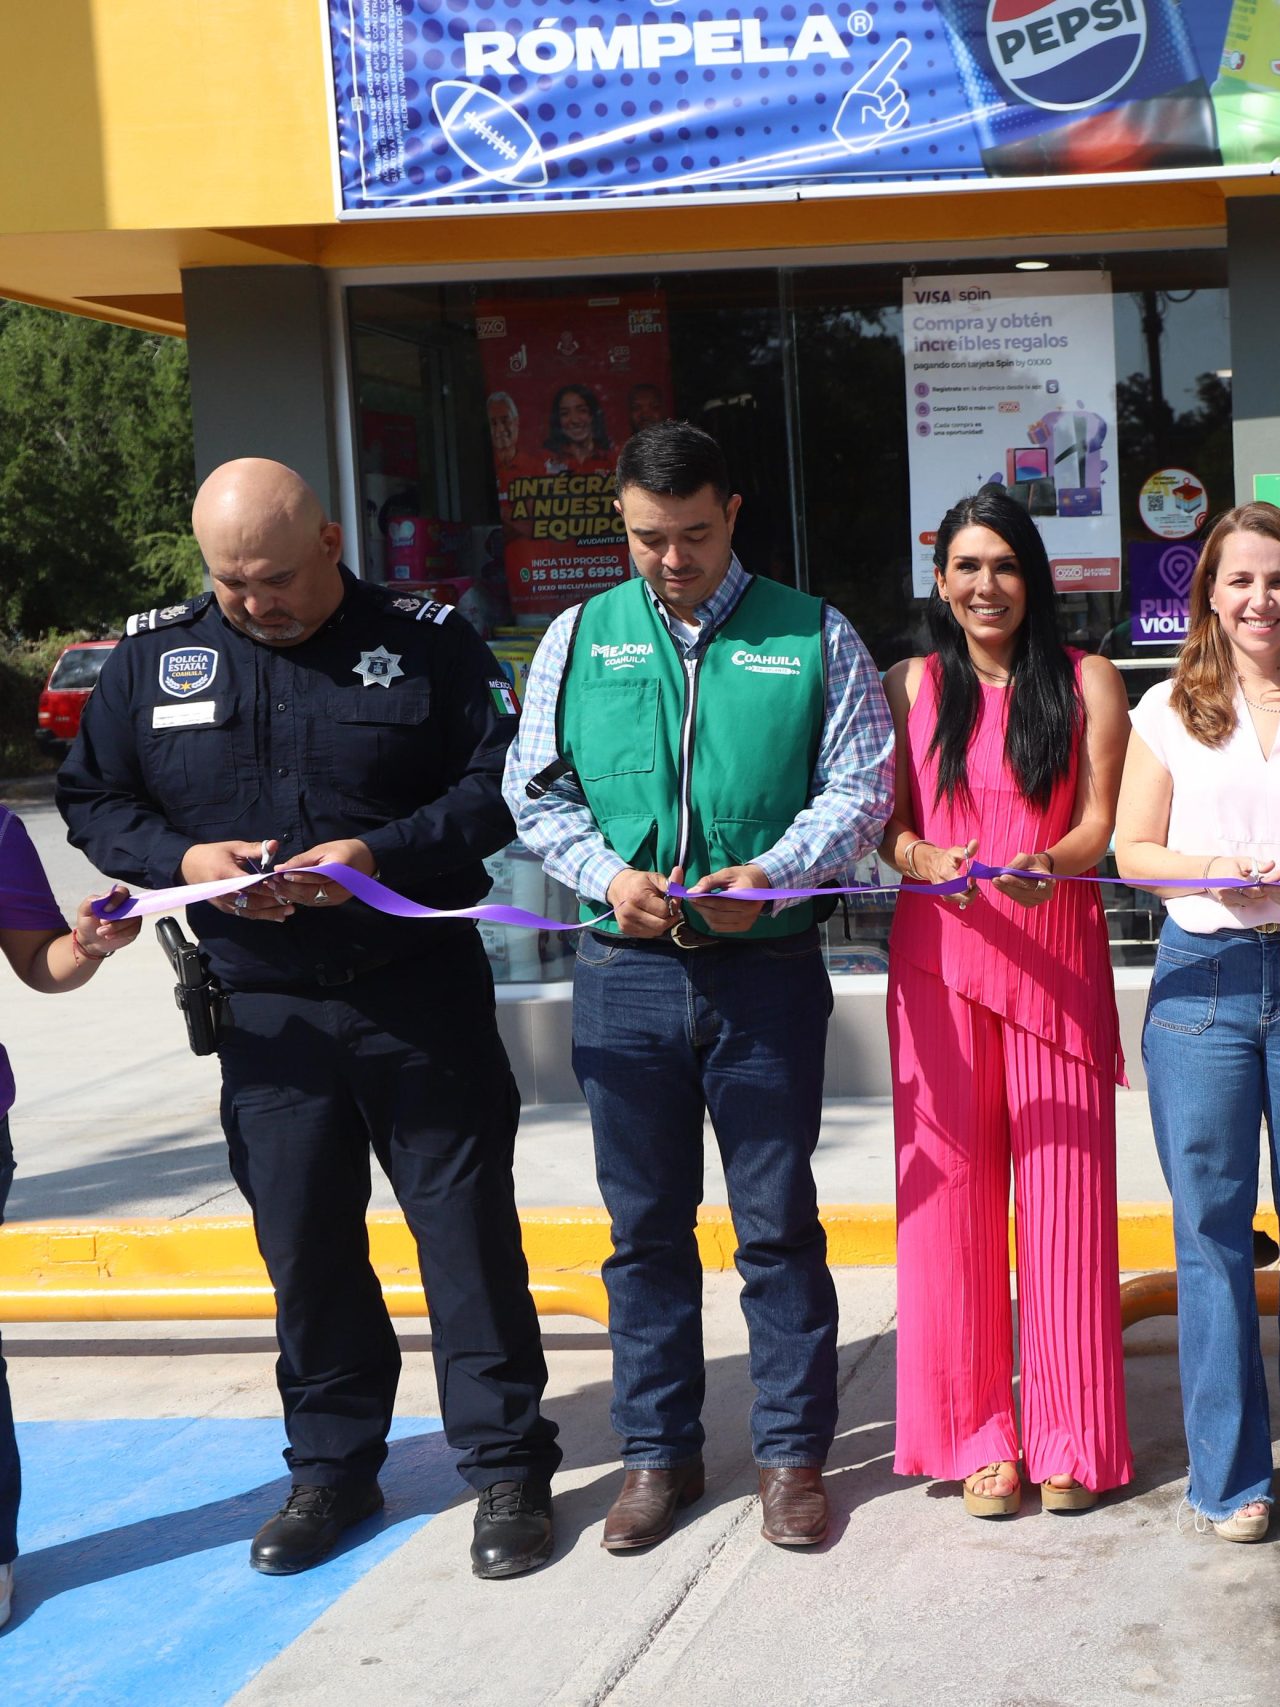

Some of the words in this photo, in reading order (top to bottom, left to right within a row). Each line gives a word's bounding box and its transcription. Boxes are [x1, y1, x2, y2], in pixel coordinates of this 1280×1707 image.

[380, 11, 387, 24] EN
[363, 20, 371, 32] DE
[371, 19, 379, 40] CON
[996, 0, 1137, 65] PEPSI
[380, 25, 388, 54] APLICA
[371, 41, 380, 71] APLICA
[380, 56, 388, 69] NO
[396, 48, 404, 61] EN
[365, 54, 375, 96] OCTUBRE
[373, 72, 381, 86] NO
[396, 62, 406, 94] VARIAR
[368, 97, 376, 110] DE
[391, 94, 400, 119] FINES
[400, 95, 410, 131] PUEDEN
[371, 123, 379, 139] DEL
[914, 290, 952, 304] VISA
[959, 288, 991, 302] spin
[913, 316, 984, 333] Compra
[987, 317, 998, 332] y
[1000, 312, 1052, 329] obtén
[914, 333, 1000, 352] increíbles
[1004, 333, 1068, 352] regalos
[913, 360, 950, 371] pagando
[951, 361, 966, 369] con
[968, 360, 995, 370] tarjeta
[996, 359, 1014, 369] Spin
[1015, 358, 1025, 368] by
[1027, 358, 1052, 367] OXXO
[509, 472, 617, 502] ¡INTÉGRA
[513, 501, 528, 519] A
[535, 497, 617, 517] NUEST
[577, 537, 615, 546] AYUDANTE
[616, 536, 626, 544] DE
[532, 558, 558, 567] INICIA
[559, 557, 572, 566] TU
[573, 555, 619, 565] PROCESO
[532, 569, 547, 580] 55
[550, 568, 585, 579] 8526
[588, 566, 624, 578] 6996
[1056, 567, 1083, 578] OXXO
[1140, 599, 1190, 618] PUN
[1140, 617, 1190, 634] VIOL
[591, 642, 654, 659] MEJORA
[731, 650, 801, 667] COAHUILA
[168, 661, 208, 673] ESTATAL
[169, 654, 209, 664] POLICÍA
[604, 655, 646, 666] COAHUILA
[171, 670, 203, 678] COAHUILA
